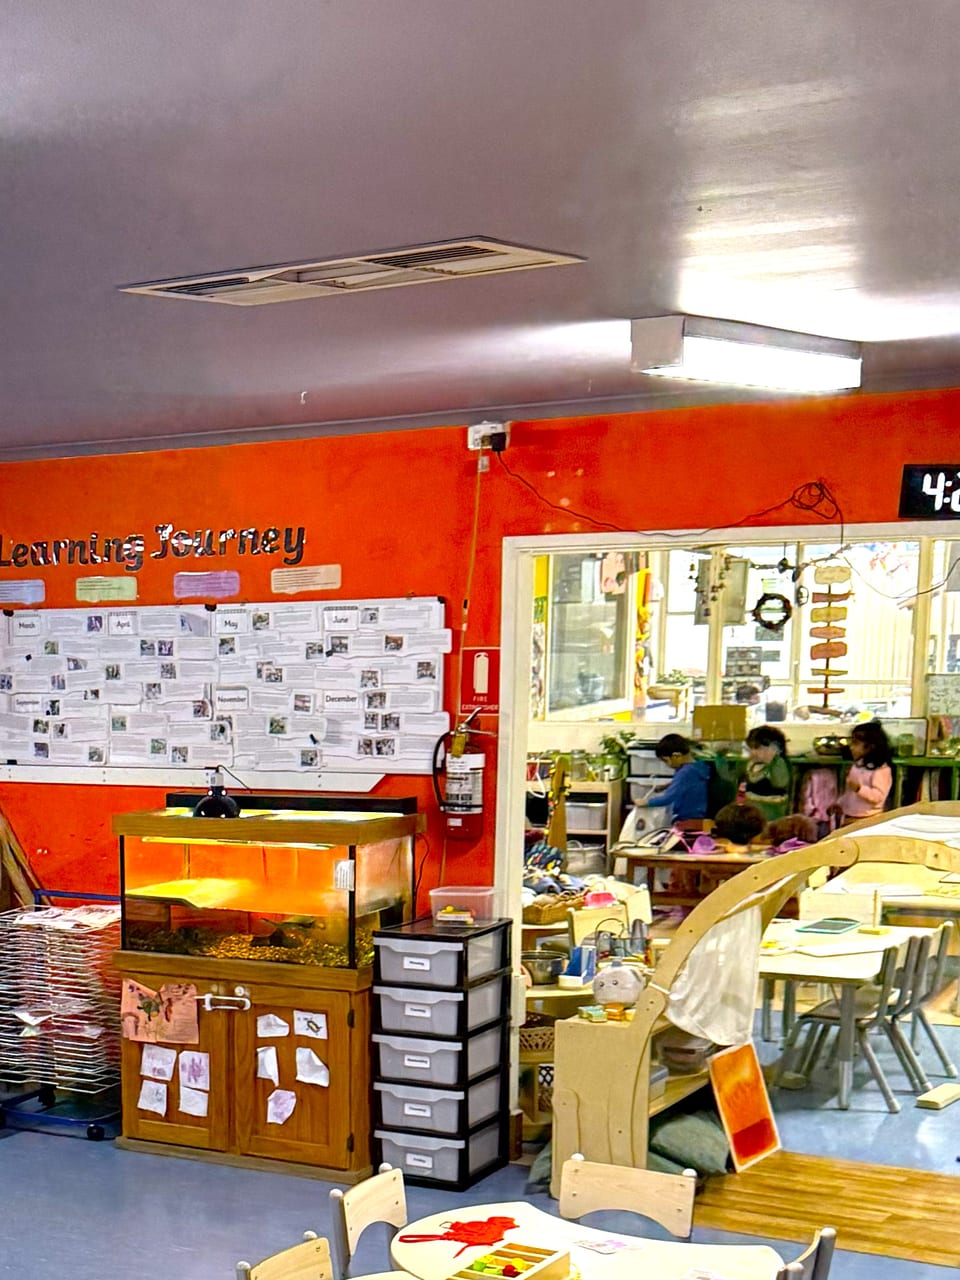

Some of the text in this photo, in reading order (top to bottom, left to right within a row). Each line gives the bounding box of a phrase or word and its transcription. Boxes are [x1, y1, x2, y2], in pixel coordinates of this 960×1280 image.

[151, 522, 305, 565] Journey
[18, 620, 36, 629] March
[116, 619, 131, 629] April
[224, 619, 239, 630] May
[332, 615, 349, 625] June
[217, 695, 247, 703] November
[325, 694, 358, 704] December
